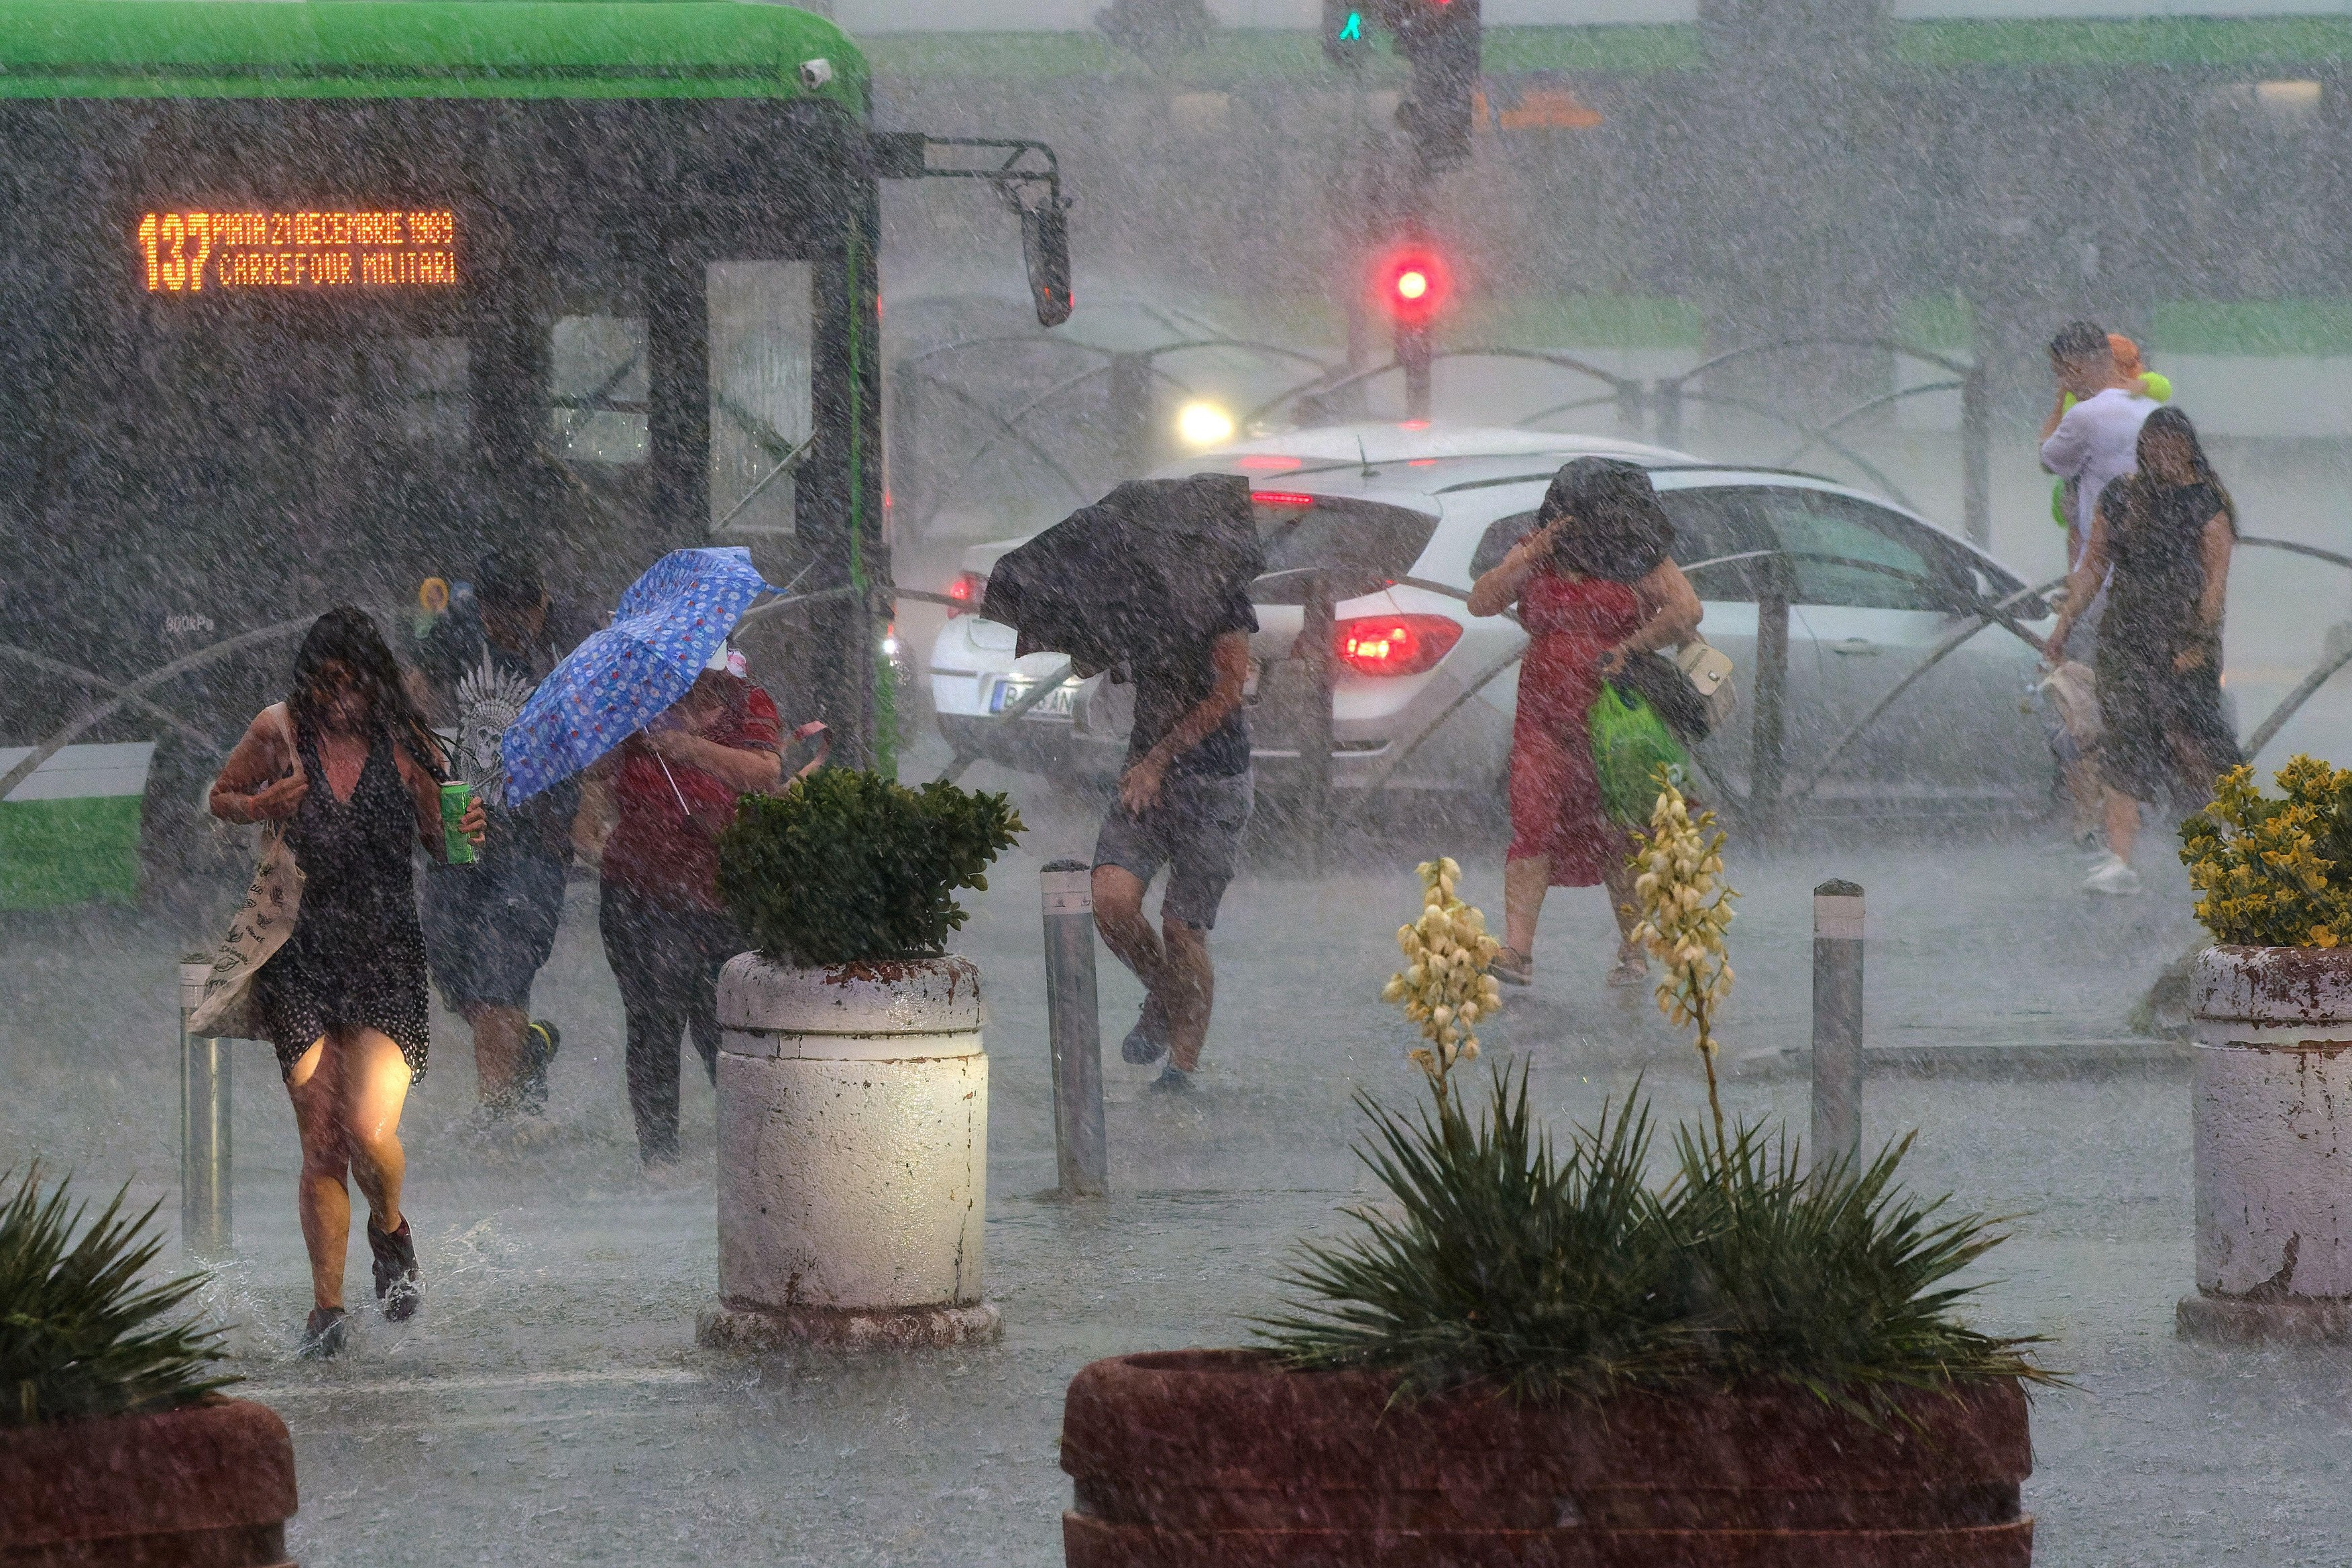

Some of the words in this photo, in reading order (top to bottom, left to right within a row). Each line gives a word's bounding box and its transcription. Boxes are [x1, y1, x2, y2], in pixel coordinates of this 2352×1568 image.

[213, 213, 266, 245] PIATA
[271, 213, 290, 244] 21
[295, 212, 403, 244] DECEMBRIE
[409, 212, 453, 243] 1989
[139, 213, 209, 290] 137
[219, 252, 353, 285] CARREFOUR
[362, 251, 455, 284] MILITARI
